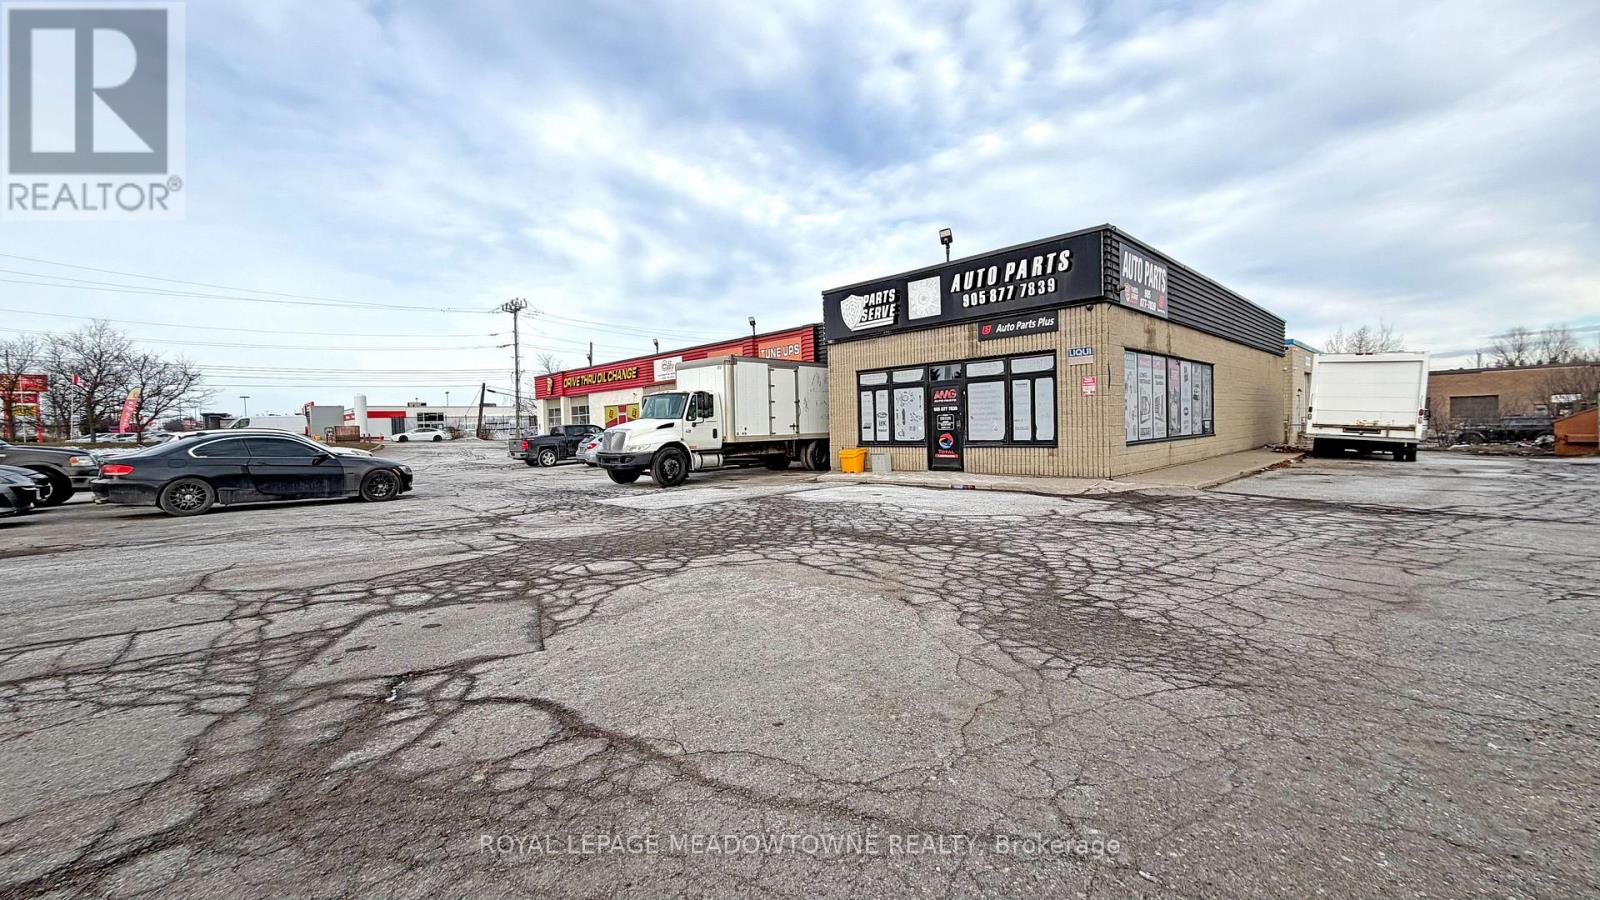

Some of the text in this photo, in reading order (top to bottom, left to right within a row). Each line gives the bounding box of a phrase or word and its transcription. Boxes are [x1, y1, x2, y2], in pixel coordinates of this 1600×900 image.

[950, 249, 1070, 293] AUTO PARTS
[1122, 251, 1167, 293] AUTO PARTS
[863, 288, 896, 307] PARTS
[962, 277, 1056, 308] 905 877 7839
[861, 303, 896, 322] SERVE
[996, 316, 1055, 334] Auto Parts Plus
[760, 344, 800, 359] TUNE UPS
[563, 367, 638, 388] DRIVE THRU OIL CHANGE
[934, 389, 957, 400] AMG
